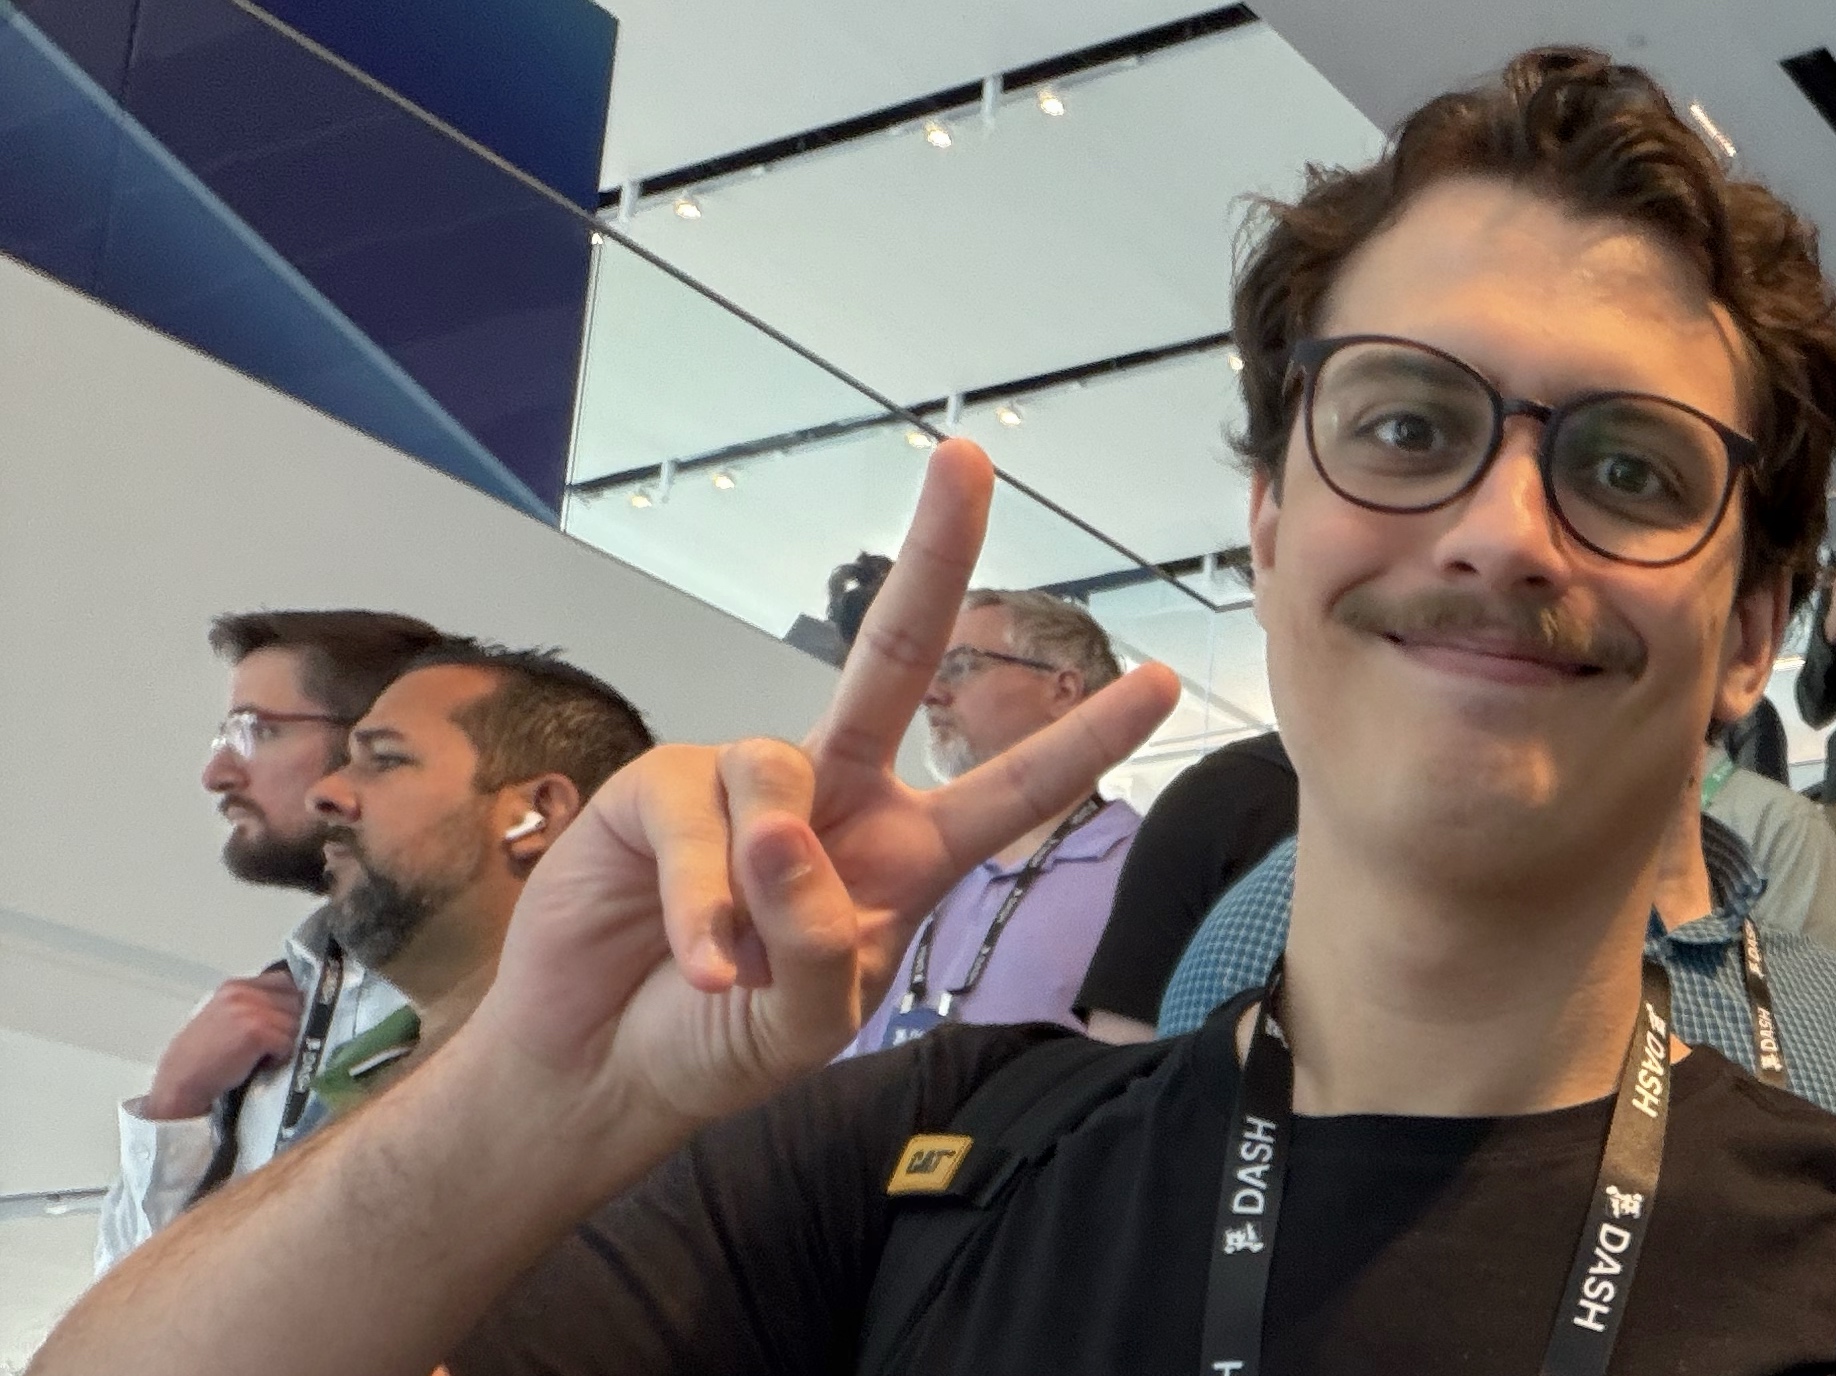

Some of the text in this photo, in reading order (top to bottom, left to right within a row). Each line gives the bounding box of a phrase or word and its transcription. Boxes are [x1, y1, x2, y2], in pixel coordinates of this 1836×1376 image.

[1757, 1007, 1778, 1051] DASH
[1632, 1033, 1667, 1117] DASH
[905, 1149, 957, 1175] CAT
[1232, 1117, 1275, 1214] DASH
[1574, 1223, 1631, 1333] DASH
